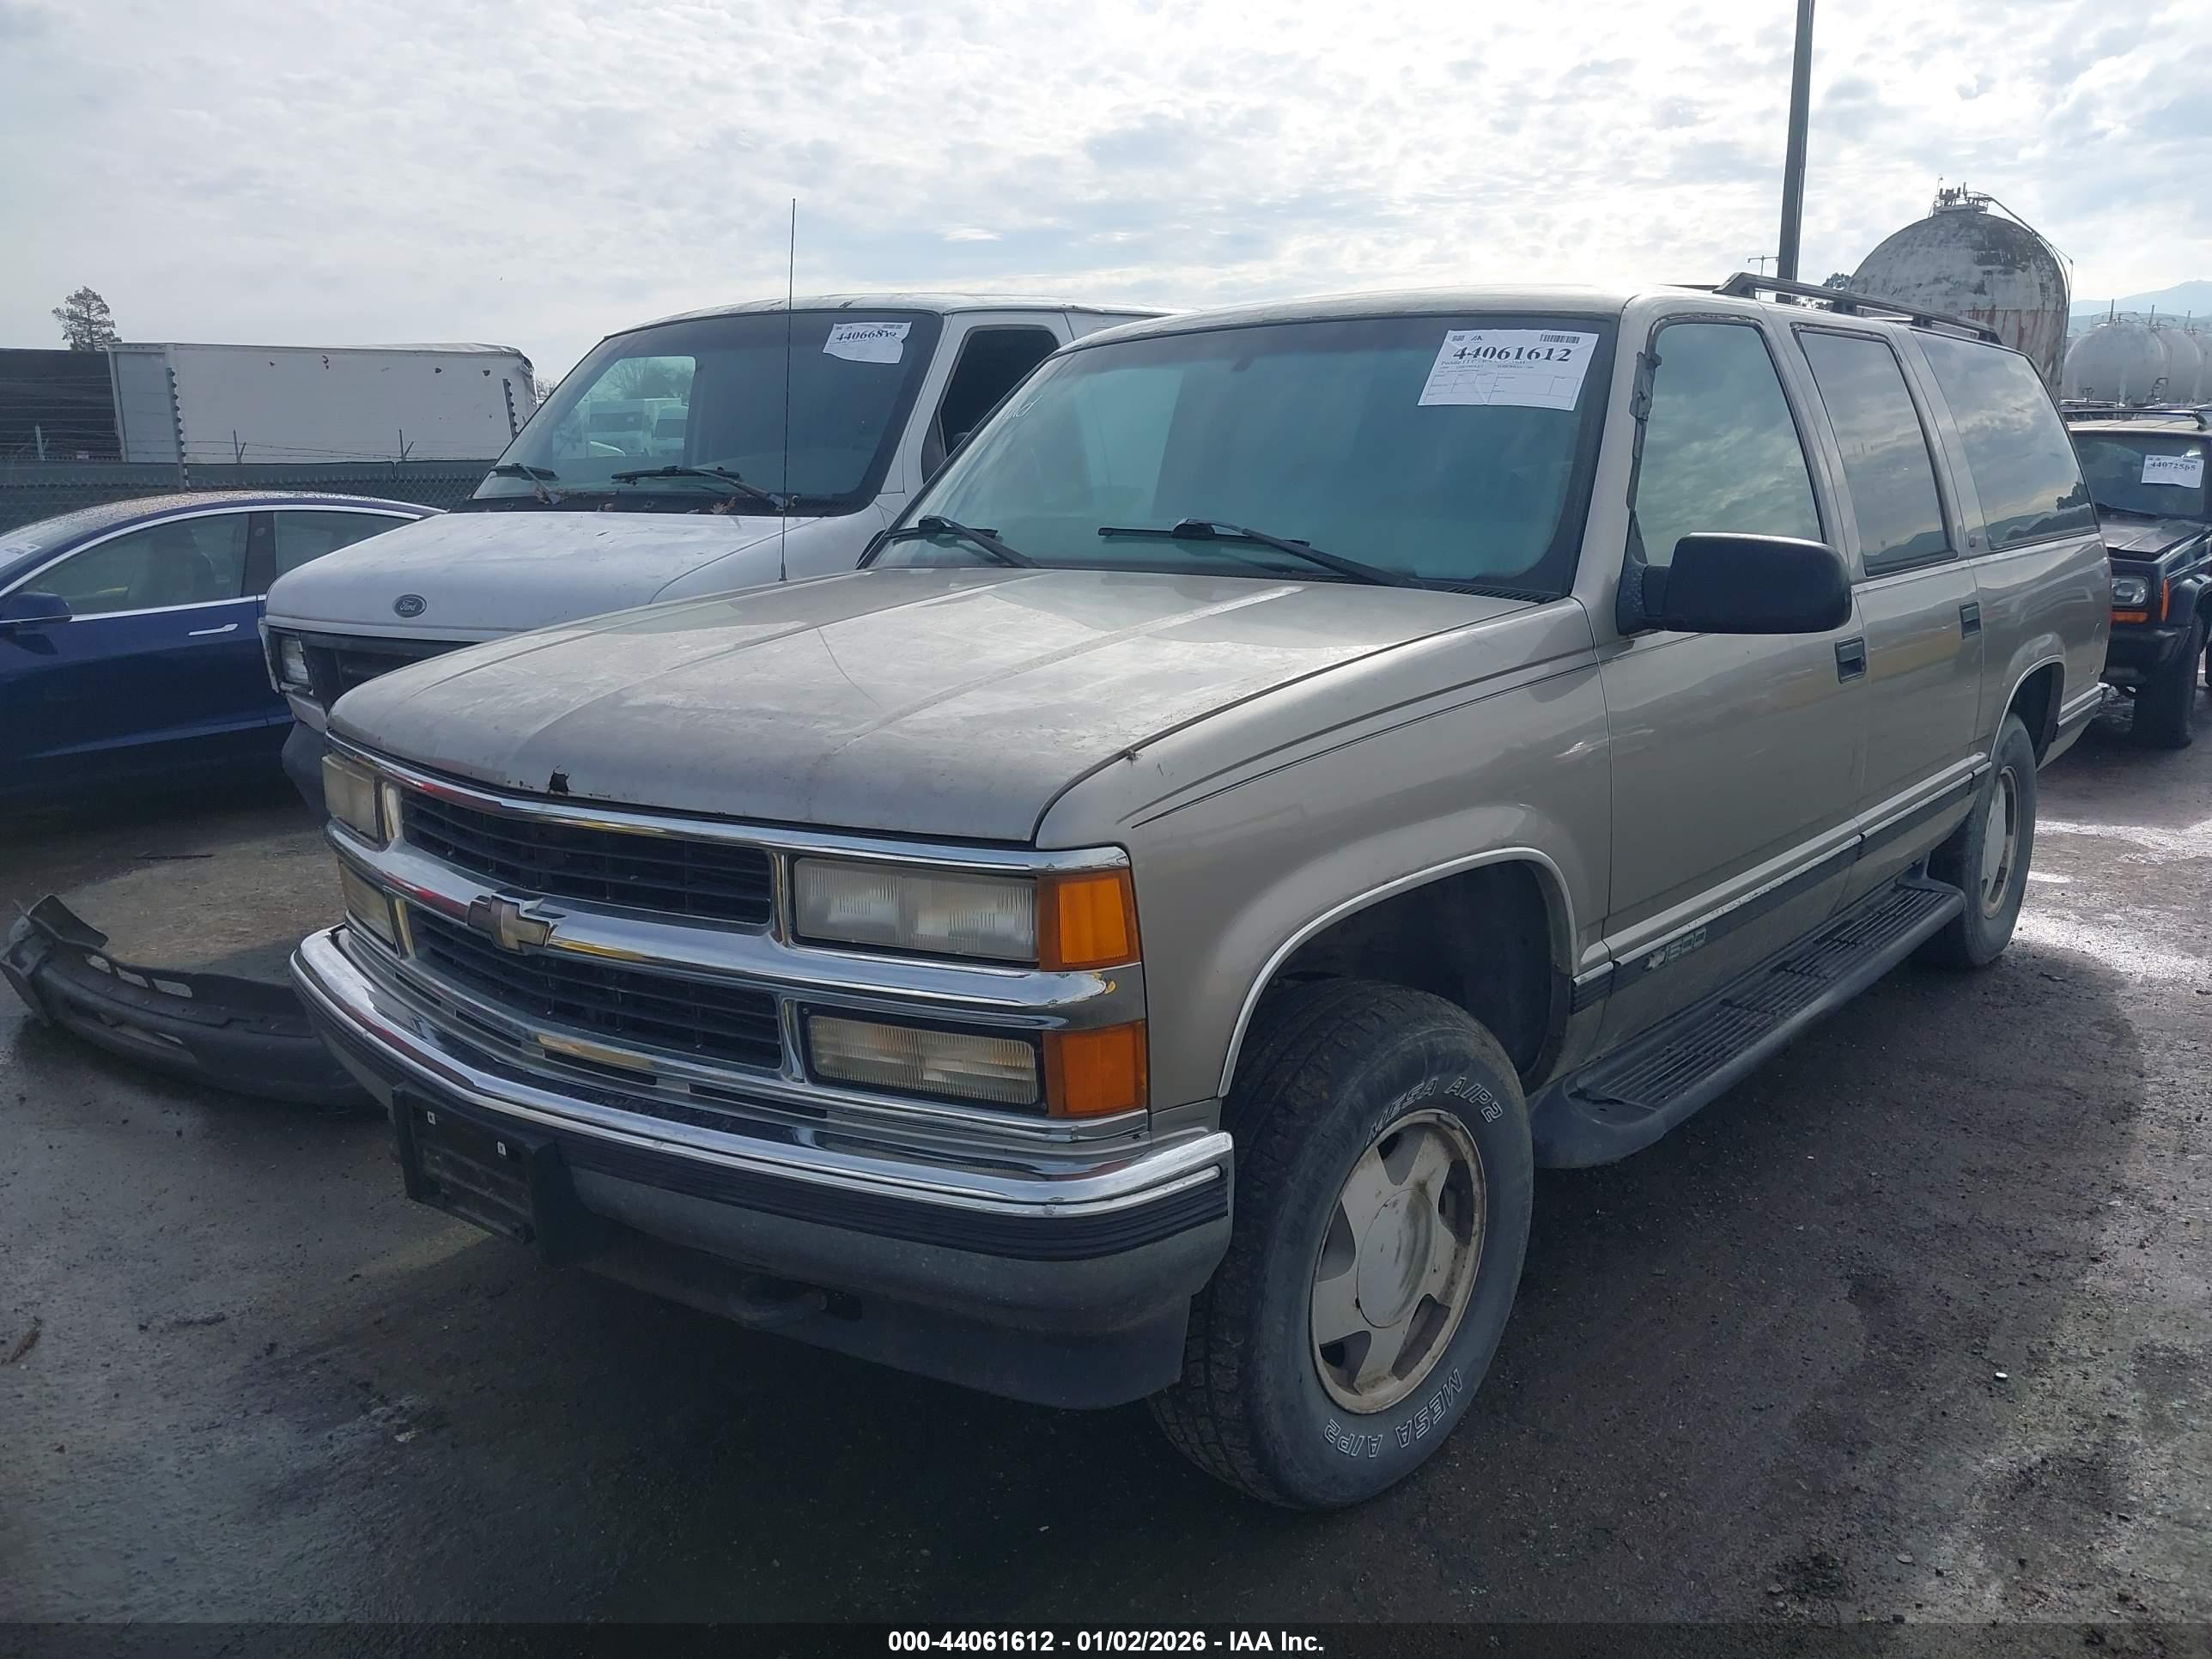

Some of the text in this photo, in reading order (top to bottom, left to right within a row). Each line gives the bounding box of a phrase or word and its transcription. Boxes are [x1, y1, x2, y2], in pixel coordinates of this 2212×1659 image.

[1453, 346, 1572, 362] 44061612
[1365, 1078, 1439, 1146] MESA
[1395, 1367, 1464, 1449] MESA
